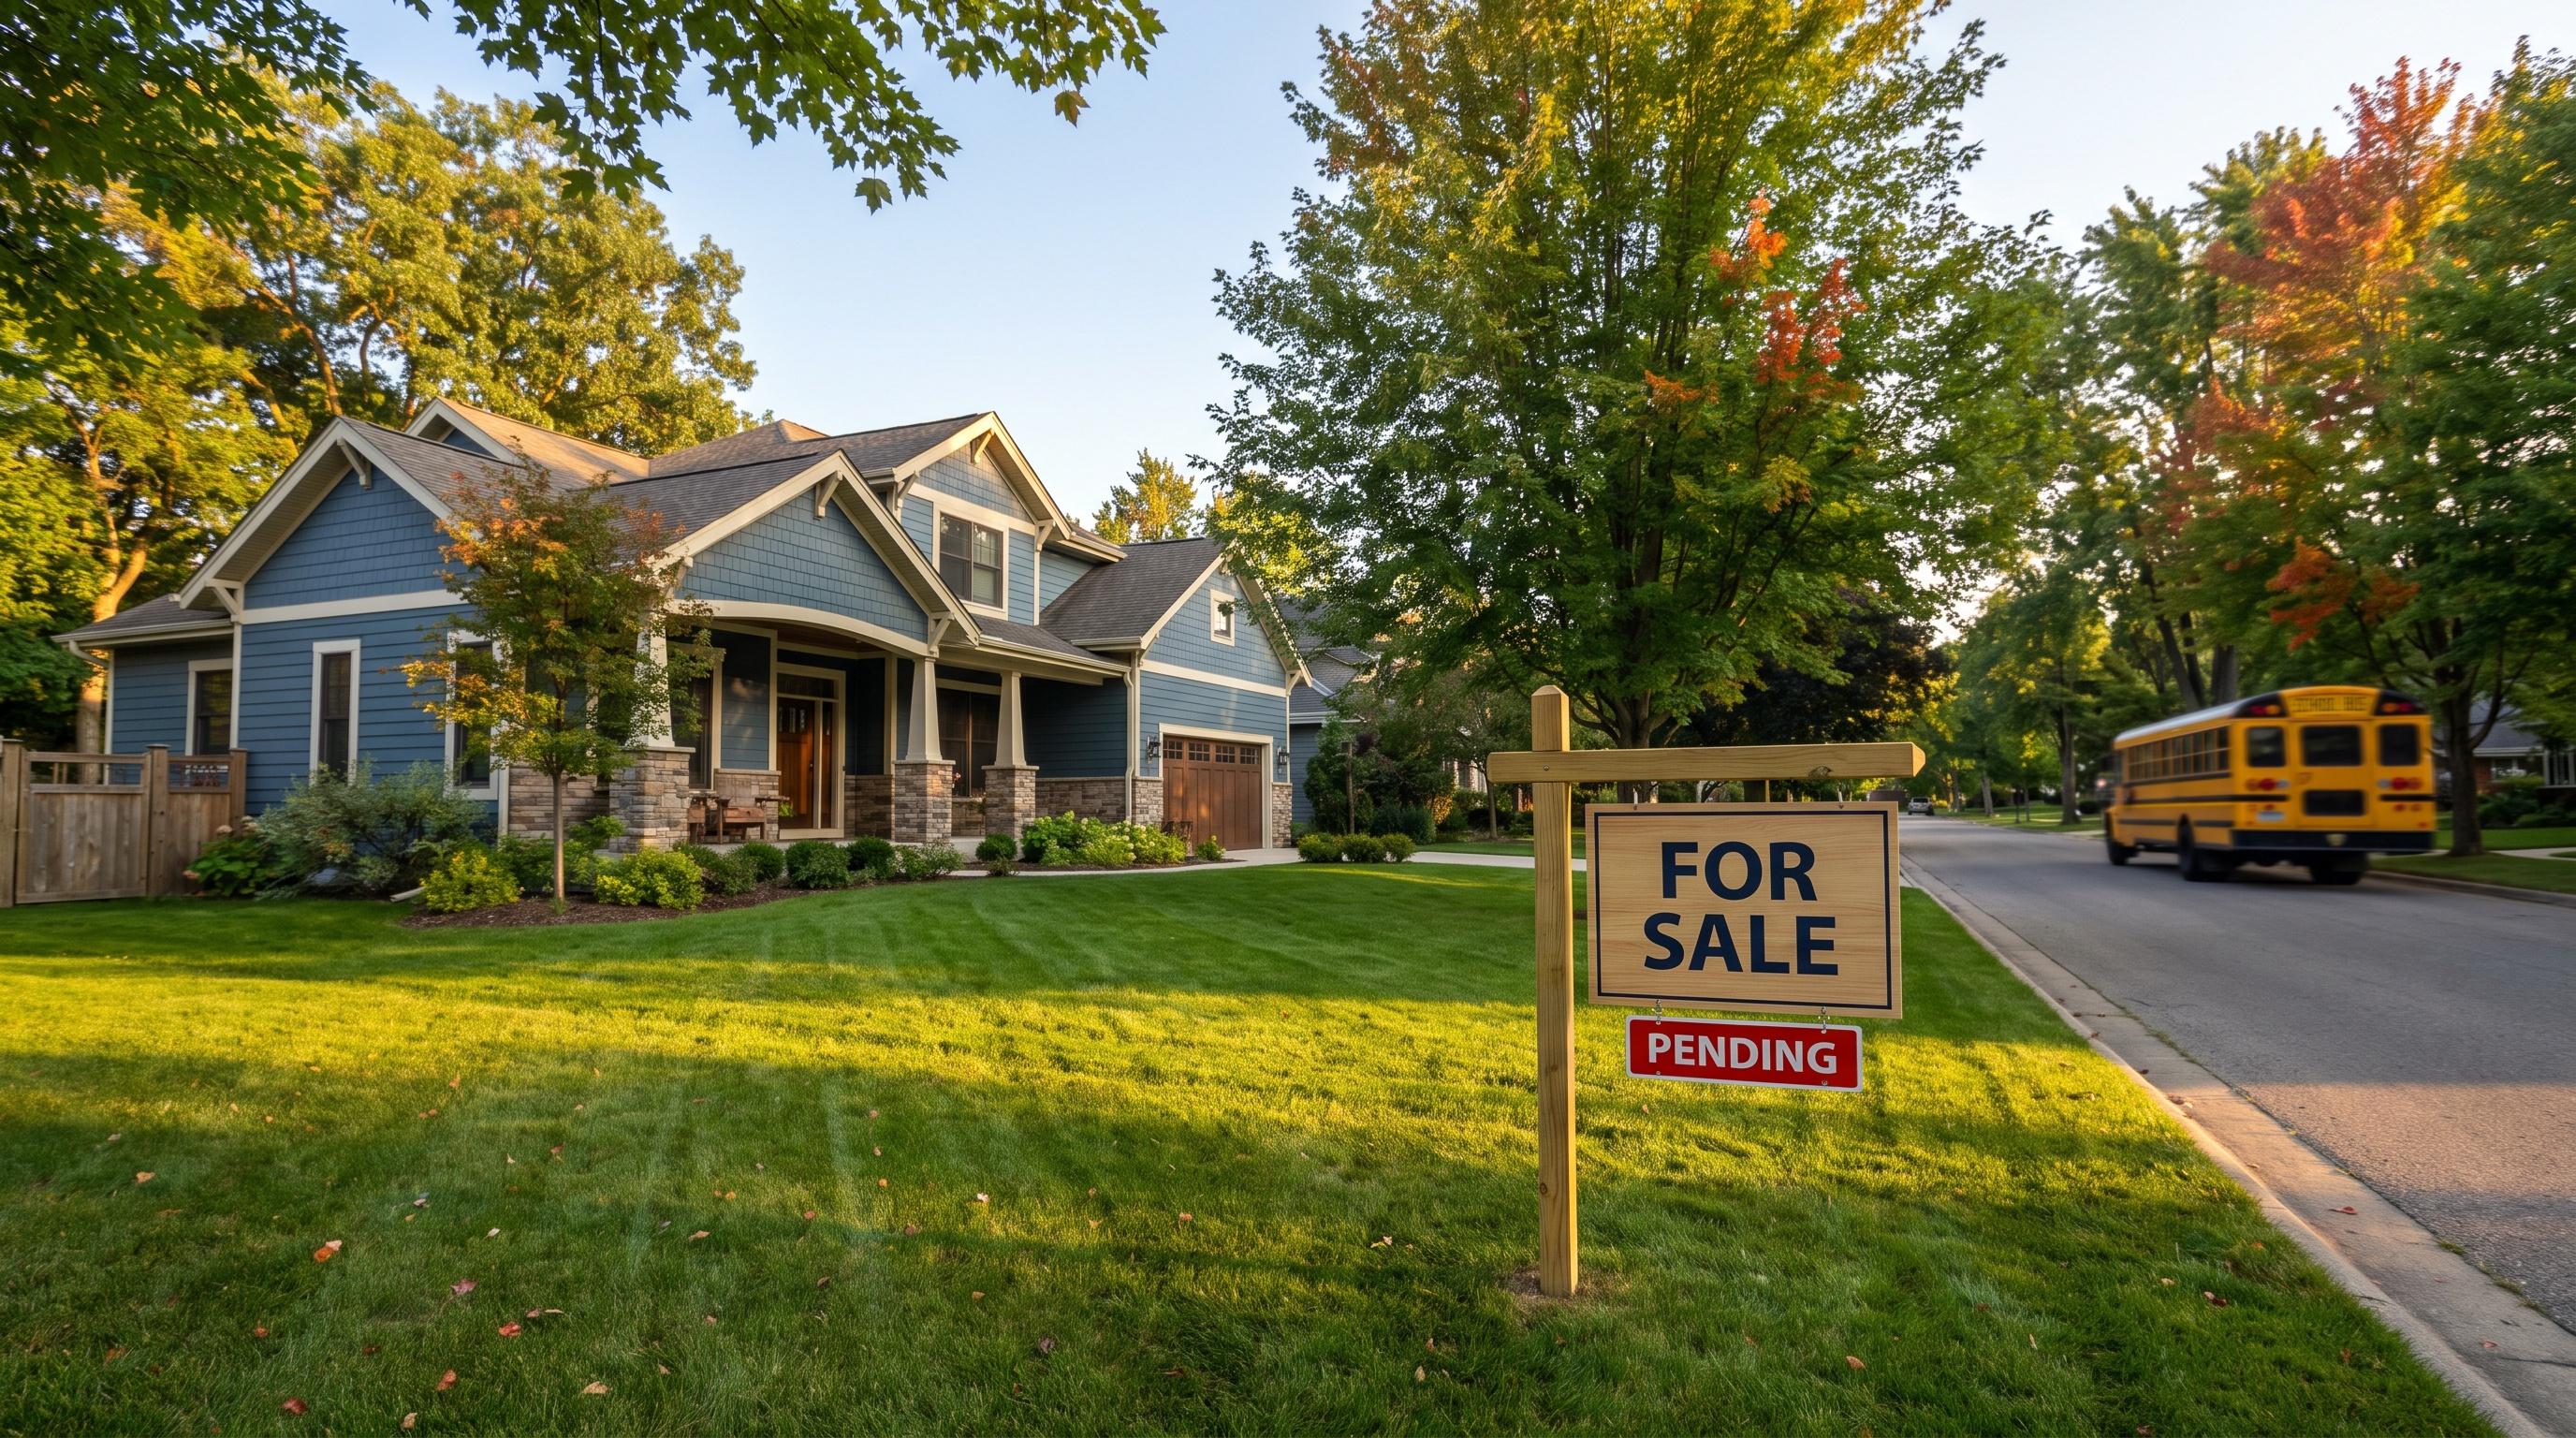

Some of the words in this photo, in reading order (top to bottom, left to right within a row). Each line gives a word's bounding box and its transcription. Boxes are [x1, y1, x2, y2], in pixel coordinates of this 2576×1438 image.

[1661, 841, 1818, 901] FOR
[1644, 912, 1838, 976] SALE
[1648, 1033, 1837, 1074] PENDING
